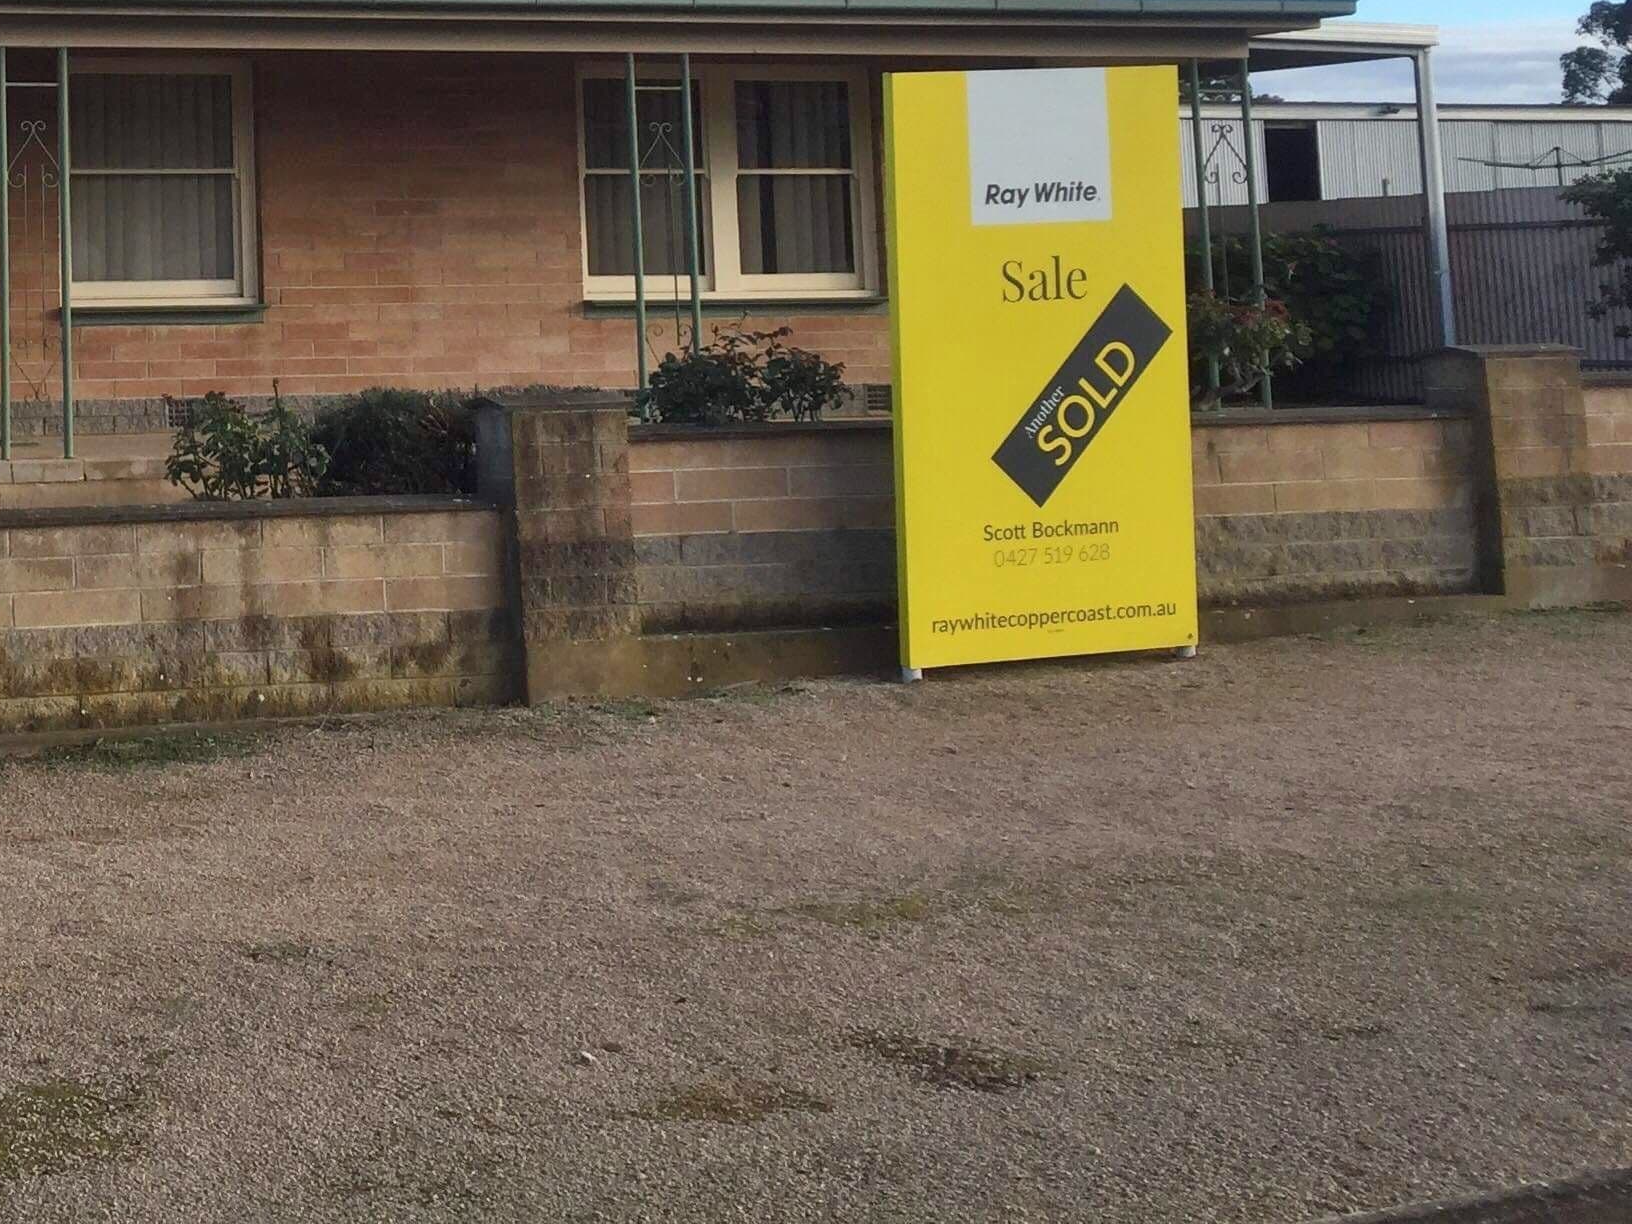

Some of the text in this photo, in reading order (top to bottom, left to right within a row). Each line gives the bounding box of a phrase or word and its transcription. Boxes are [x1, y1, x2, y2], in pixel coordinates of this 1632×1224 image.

[984, 180, 1098, 209] Ray White
[1001, 255, 1088, 304] Sale
[1023, 384, 1065, 440] Another
[1037, 340, 1136, 466] SOLD
[983, 518, 1119, 542] Scott Bockmann
[993, 542, 1110, 568] 0427 519 628
[931, 601, 1177, 636] raywhitecoppercoast.com.au
